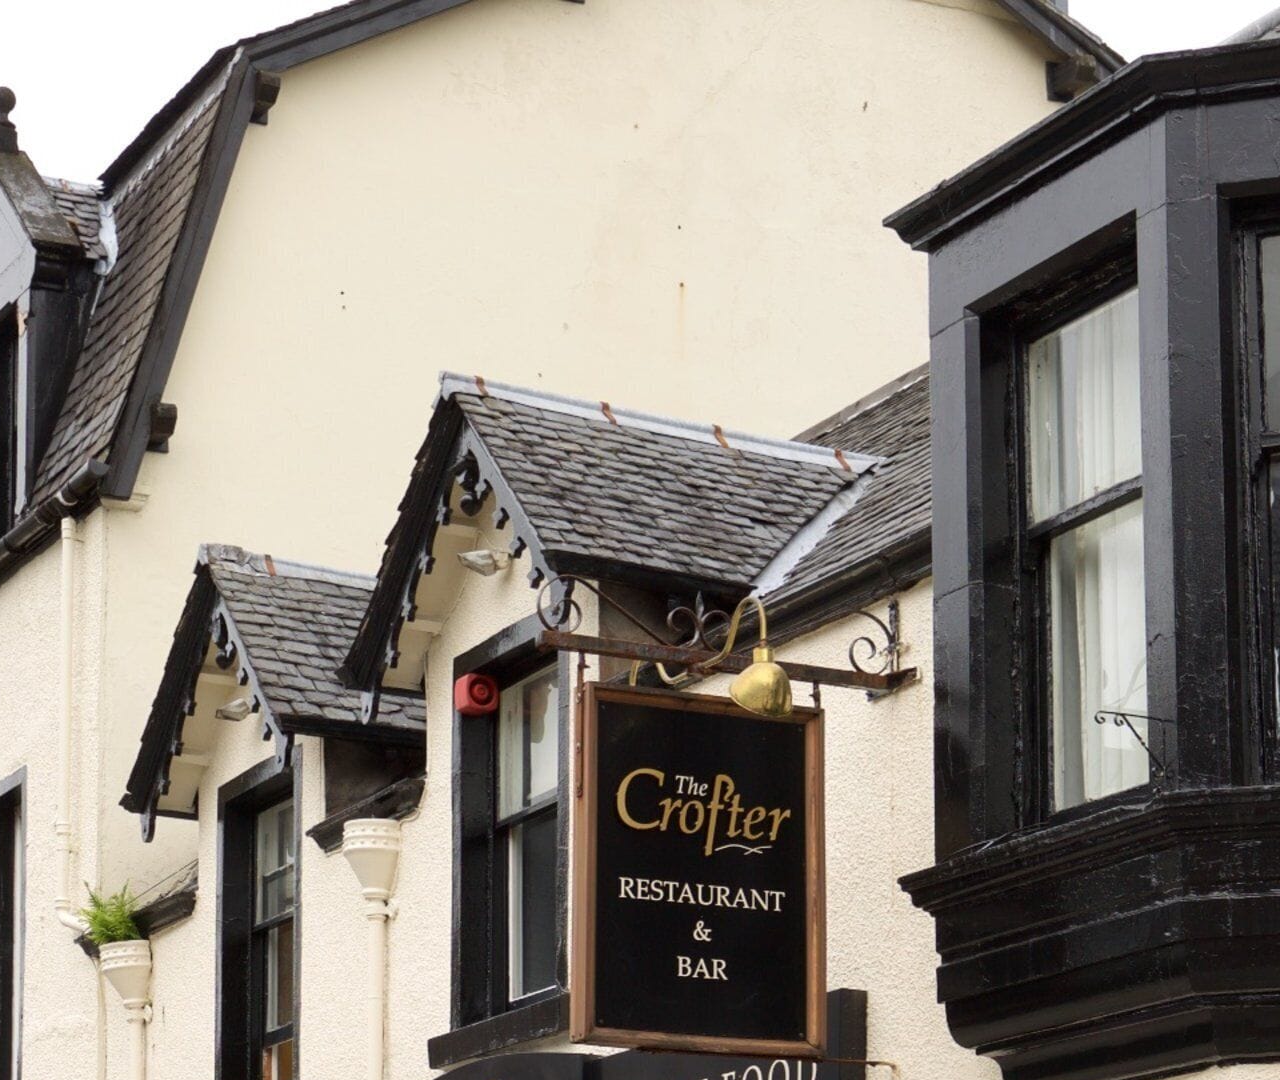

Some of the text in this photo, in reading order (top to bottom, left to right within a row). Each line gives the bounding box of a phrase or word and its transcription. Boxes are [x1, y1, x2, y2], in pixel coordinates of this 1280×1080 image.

[676, 775, 708, 797] The
[616, 768, 791, 856] Crofter
[619, 876, 785, 912] RESTAURANT
[693, 921, 712, 941] &
[677, 955, 728, 980] BAR
